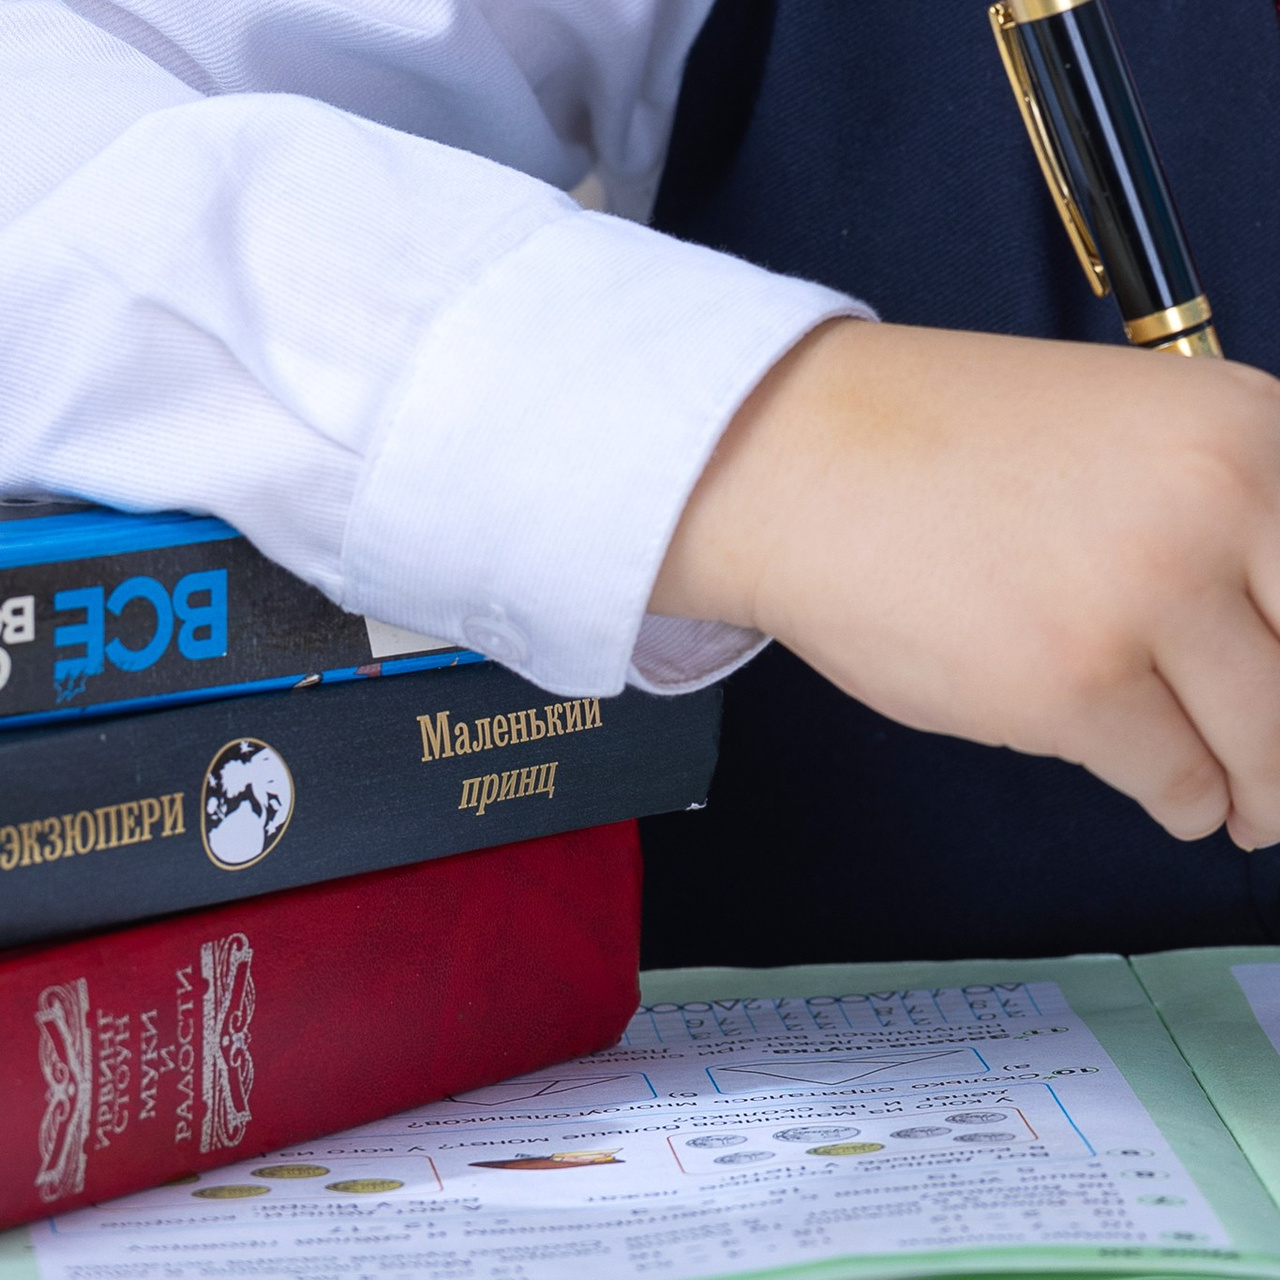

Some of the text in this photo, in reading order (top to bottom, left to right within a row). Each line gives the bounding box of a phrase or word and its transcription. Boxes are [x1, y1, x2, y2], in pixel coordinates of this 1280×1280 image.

[53, 569, 228, 684] ВСЕ
[458, 762, 558, 815] принц
[0, 792, 187, 870] ЭКЗЮПЕРИ
[690, 1023, 1004, 1049] получилось восемь.
[867, 1033, 955, 1043] столе
[967, 1028, 1009, 1037] На
[697, 1046, 750, 1056] три
[759, 1033, 1010, 1055] Задача-шутка.
[764, 1039, 856, 1048] лежат
[159, 1045, 176, 1072] И
[175, 965, 194, 1143] РАДОСТИ
[113, 1013, 131, 1134] СТОУН
[139, 1009, 158, 1121] МУКИ
[95, 1009, 114, 1149] ИРВИНГ
[909, 1074, 1041, 1090] Сколько
[714, 1086, 897, 1105] спряталось
[916, 1090, 1010, 1103] денег
[916, 1098, 982, 1110] кого
[408, 1100, 699, 1130] многоугольников?
[671, 1108, 813, 1123] сколько?
[690, 1110, 856, 1126] мальчиков
[562, 1125, 680, 1139] больше
[439, 1138, 549, 1149] монет?
